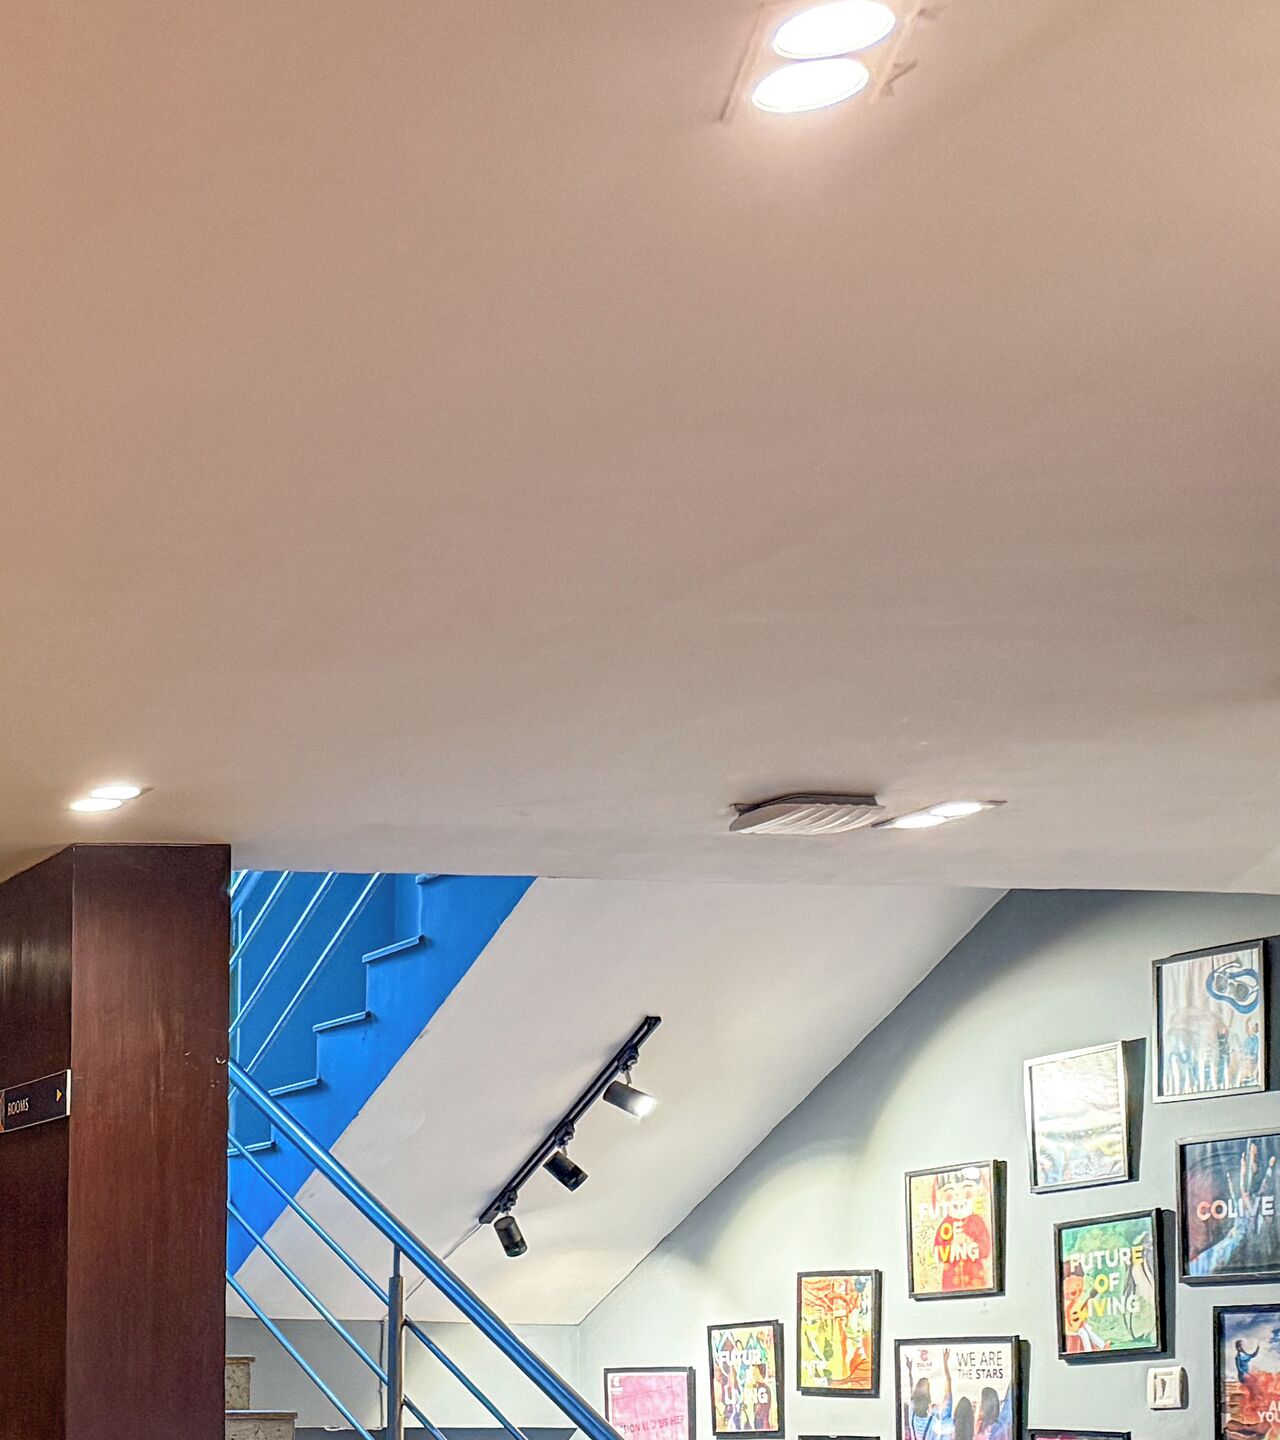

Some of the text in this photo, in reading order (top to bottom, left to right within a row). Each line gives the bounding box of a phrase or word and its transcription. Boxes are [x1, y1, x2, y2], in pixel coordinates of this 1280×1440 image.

[7, 1097, 29, 1116] ROOMS
[1069, 1245, 1144, 1273] FUTURE
[1095, 1273, 1120, 1294] OF
[1082, 1295, 1141, 1320] IVING
[956, 1351, 1003, 1367] WE ARE
[957, 1368, 1004, 1380] THE STARS
